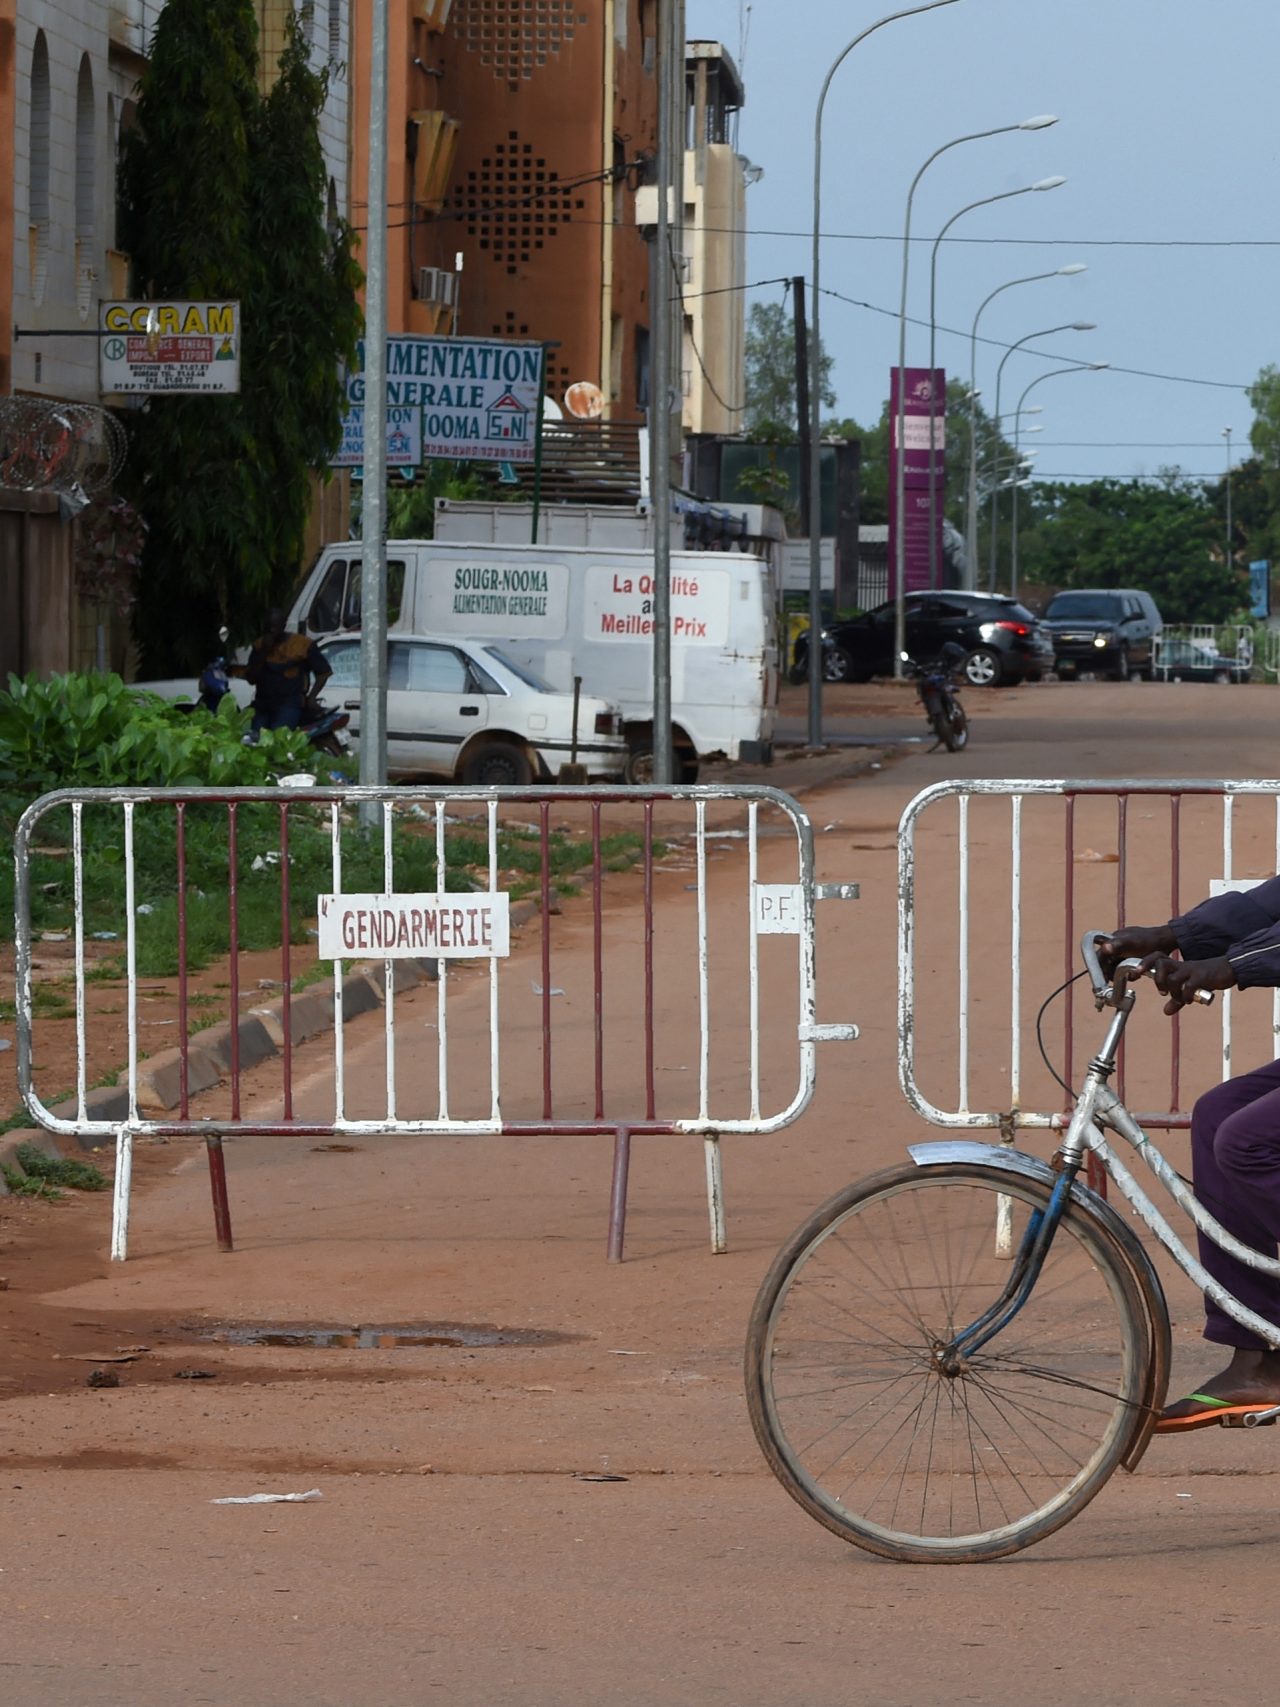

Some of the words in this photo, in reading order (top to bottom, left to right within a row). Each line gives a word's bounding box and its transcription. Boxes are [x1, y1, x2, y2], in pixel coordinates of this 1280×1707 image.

[349, 379, 484, 408] GNERALE
[613, 574, 632, 593] La
[638, 575, 699, 596] Qlité
[452, 594, 508, 615] ALIMENTATION
[508, 596, 548, 616] GENERALE
[641, 599, 656, 614] a
[673, 616, 706, 637] Prix
[342, 907, 493, 949] GENDARMERIE
